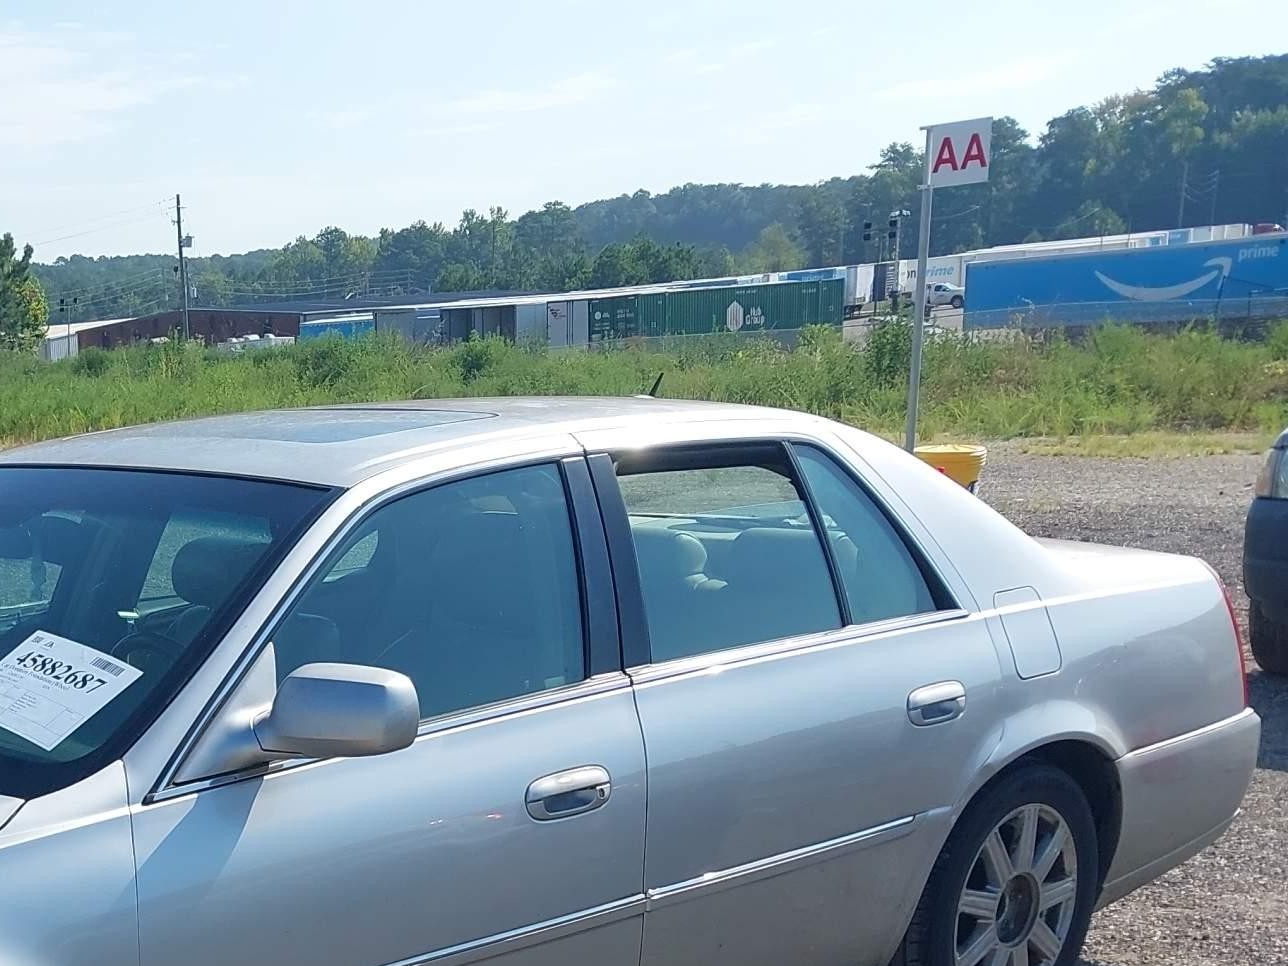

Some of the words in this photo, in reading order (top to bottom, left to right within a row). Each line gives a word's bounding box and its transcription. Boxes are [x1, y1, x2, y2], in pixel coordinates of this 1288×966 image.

[932, 132, 987, 173] AA
[1238, 244, 1280, 262] prime
[925, 265, 954, 278] rime
[16, 651, 108, 694] 45882687
